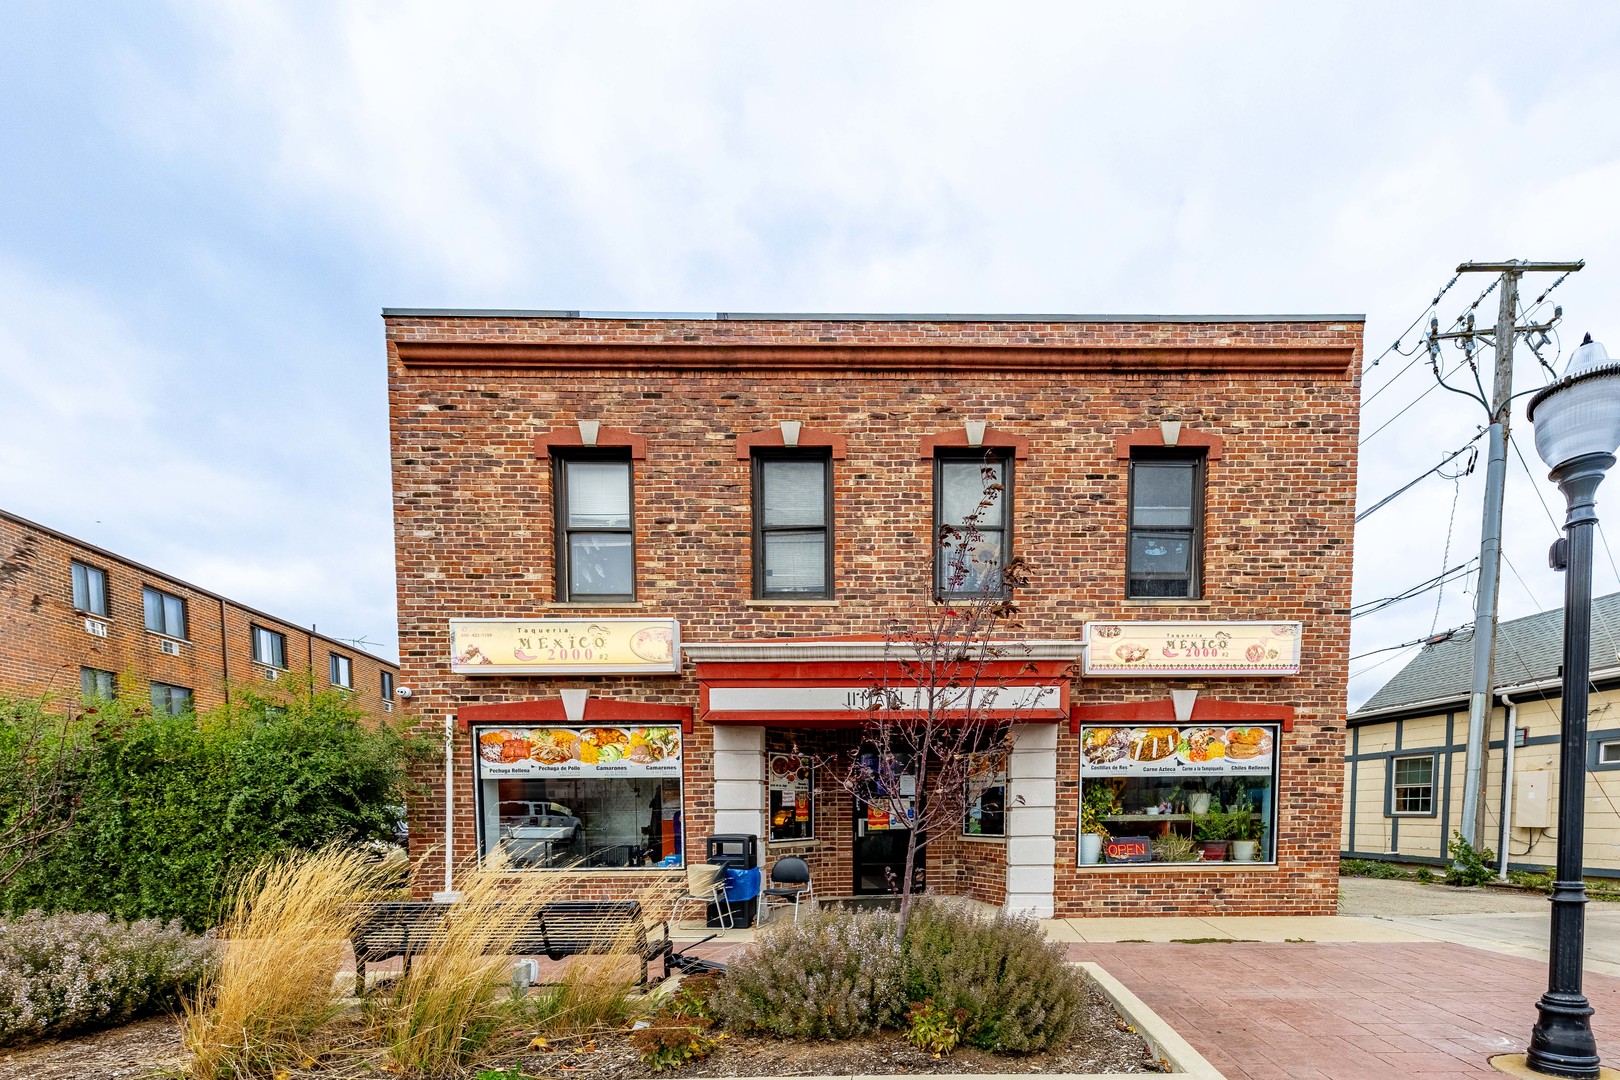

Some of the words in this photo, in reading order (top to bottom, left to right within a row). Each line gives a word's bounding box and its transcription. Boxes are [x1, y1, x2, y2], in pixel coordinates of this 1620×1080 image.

[547, 648, 593, 660] 2000
[1185, 648, 1218, 657] 2000
[1107, 843, 1145, 857] OPEN
